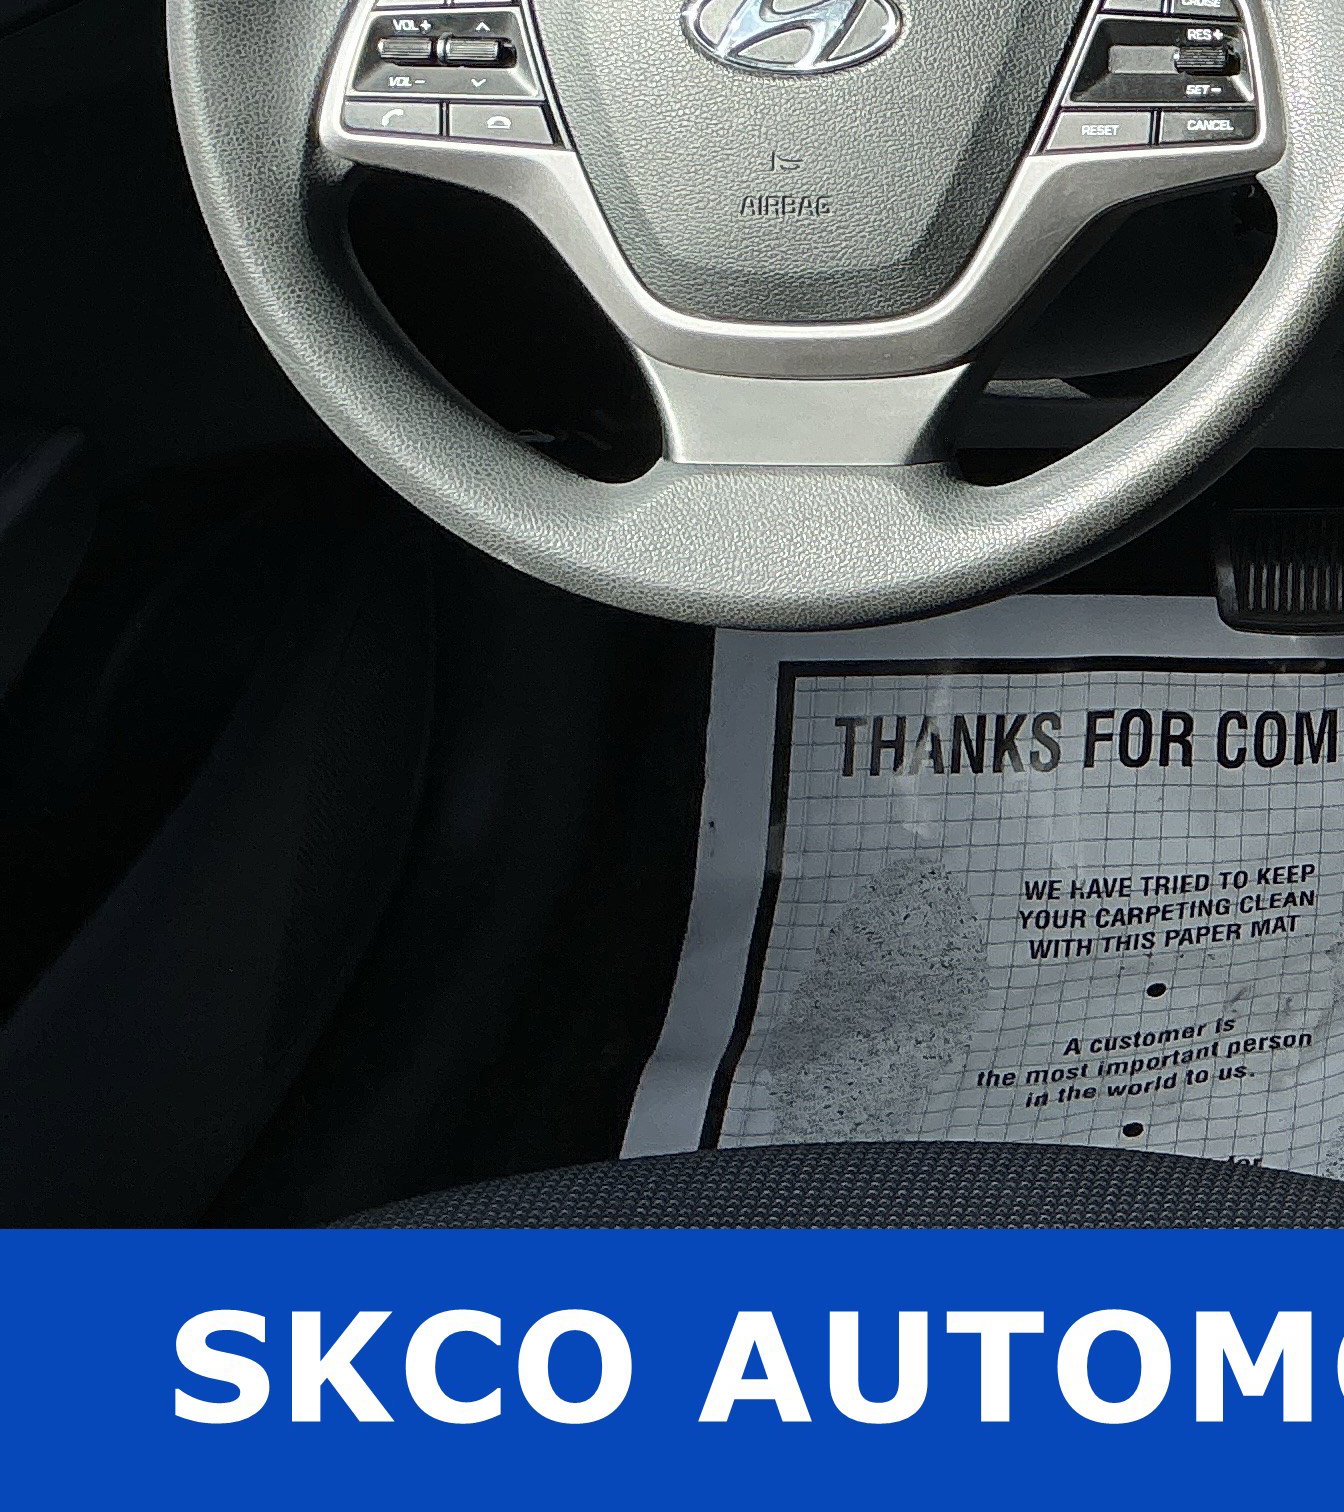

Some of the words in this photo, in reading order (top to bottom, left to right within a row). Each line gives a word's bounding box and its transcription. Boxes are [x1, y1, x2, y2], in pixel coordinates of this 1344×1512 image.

[1081, 124, 1120, 136] RESET
[1187, 120, 1234, 131] CANCEL
[739, 195, 832, 216] AIRBAG
[835, 713, 1063, 778] THANKS
[1083, 706, 1194, 770] FOR
[1024, 879, 1062, 901] WE
[1069, 877, 1132, 899] HAVE
[1140, 873, 1210, 897] TRIED
[1218, 870, 1249, 890] TO
[1256, 863, 1316, 886] KEEP
[1019, 908, 1087, 930] YOUR
[1095, 898, 1231, 929] CARPETING
[1239, 889, 1316, 914] CLEAN
[1028, 937, 1093, 960] WITH
[1101, 932, 1155, 954] THIS
[1164, 922, 1241, 948] PAPER
[1250, 914, 1300, 937] MAT
[1063, 1037, 1082, 1056] A
[1089, 1021, 1208, 1054] customer
[1214, 1017, 1236, 1034] is
[976, 1069, 1016, 1089] the
[1025, 1062, 1089, 1085] most
[1096, 1042, 1221, 1080] important
[1224, 1030, 1313, 1061] person
[1025, 1089, 1049, 1109] in
[1057, 1083, 1097, 1104] the
[1107, 1073, 1179, 1097] world
[1186, 1066, 1210, 1086] to
[1218, 1062, 1256, 1082] us.
